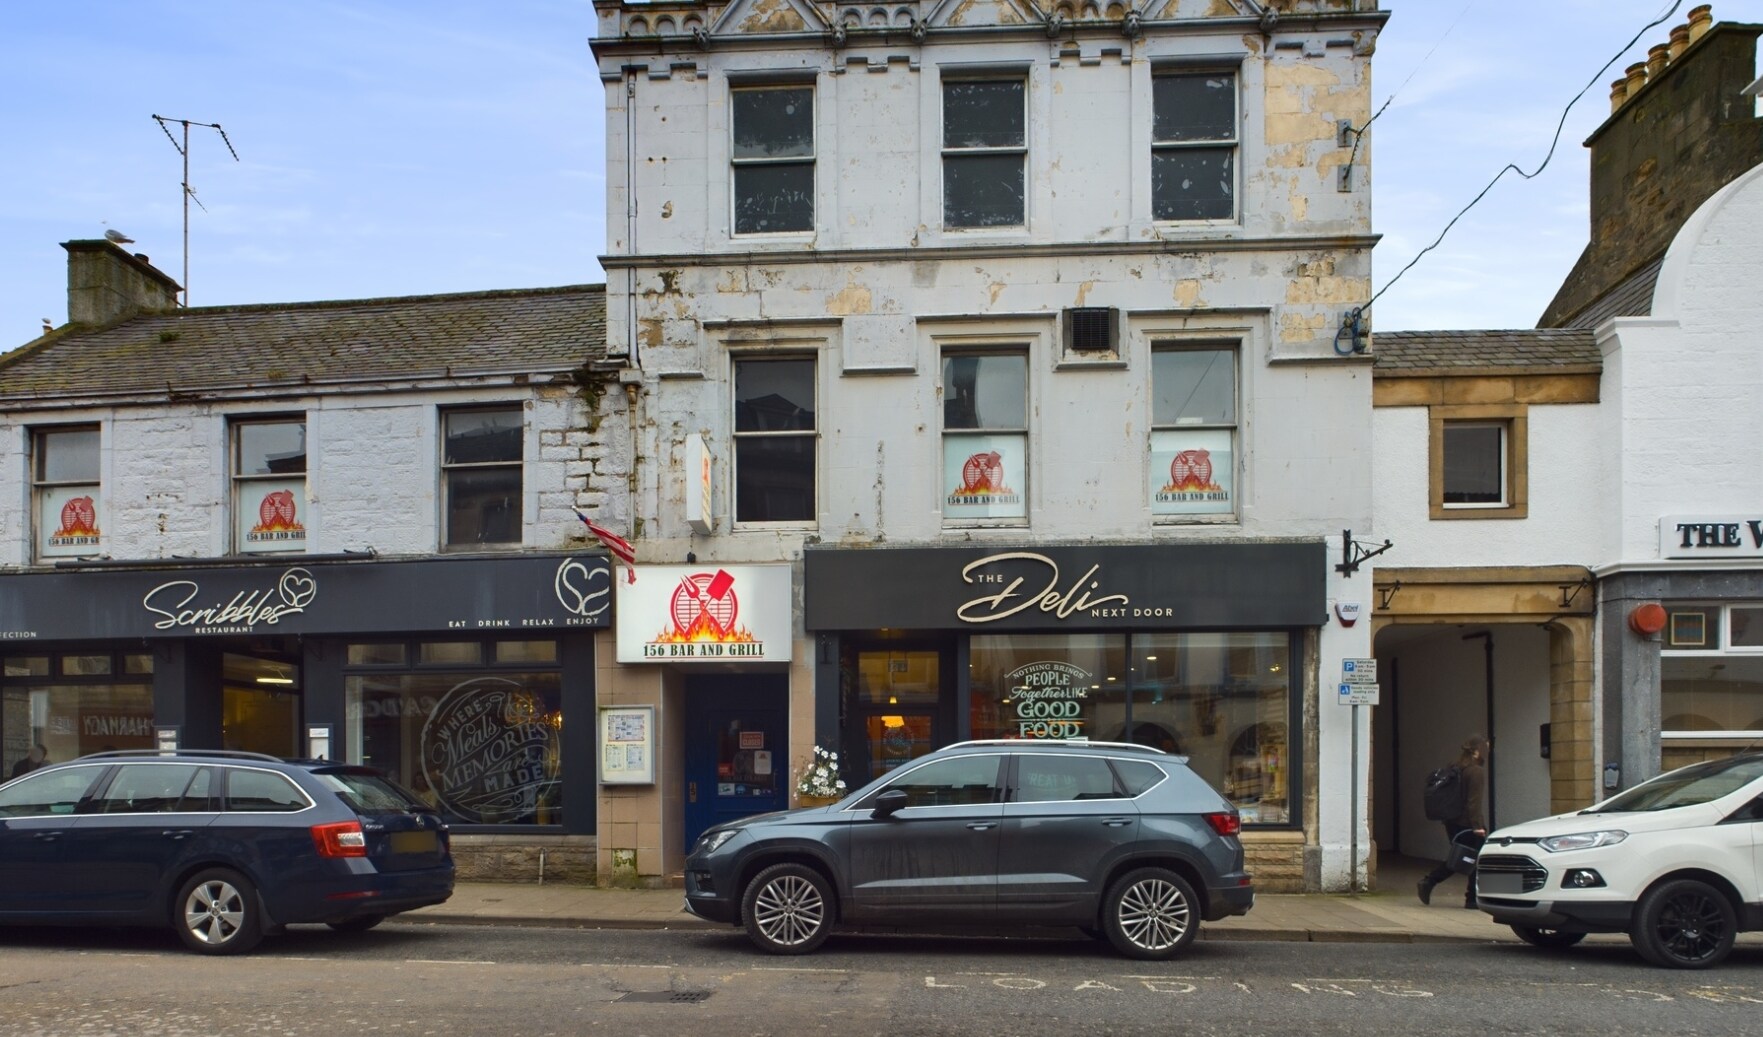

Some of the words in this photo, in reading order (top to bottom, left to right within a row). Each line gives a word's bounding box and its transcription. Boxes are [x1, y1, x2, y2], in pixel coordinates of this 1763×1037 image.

[947, 496, 961, 504] 156
[963, 496, 979, 504] BAR
[998, 495, 1020, 503] GRILL
[1155, 493, 1169, 501] 156
[1171, 493, 1187, 501] BAR
[1189, 493, 1204, 501] AND
[1207, 492, 1229, 501] GRILL
[61, 537, 74, 545] BAR
[76, 536, 89, 544] AND
[246, 533, 258, 541] 156
[260, 532, 274, 540] BAR
[276, 531, 289, 539] AND
[1677, 523, 1742, 548] THE
[978, 574, 1004, 583] THE
[957, 552, 1129, 623] Deli
[144, 580, 304, 629] Scribbles
[1091, 608, 1126, 617] NEXT
[1133, 608, 1174, 617] DOOR
[195, 626, 254, 634] RESTAURANT
[448, 620, 467, 628] EAT
[478, 619, 511, 627] DRINK
[522, 618, 554, 626] RELAX
[566, 617, 600, 625] ENJOY
[0, 631, 37, 639] ECTION
[643, 644, 665, 656] 156
[670, 644, 695, 656] BAR
[700, 644, 724, 656] AND
[728, 643, 765, 656] GRILL
[1012, 663, 1051, 679] NOTHING
[1053, 664, 1085, 679] BRINGS
[1025, 671, 1071, 686] PEOPLE
[1009, 686, 1067, 703] Together
[1066, 687, 1089, 698] LIKE
[1017, 701, 1080, 718] GOOD
[437, 698, 484, 741] WHERE
[1019, 722, 1080, 738] FOOD
[432, 714, 500, 772] Meals
[442, 720, 550, 792] MEMORIES
[483, 765, 546, 793] MADE
